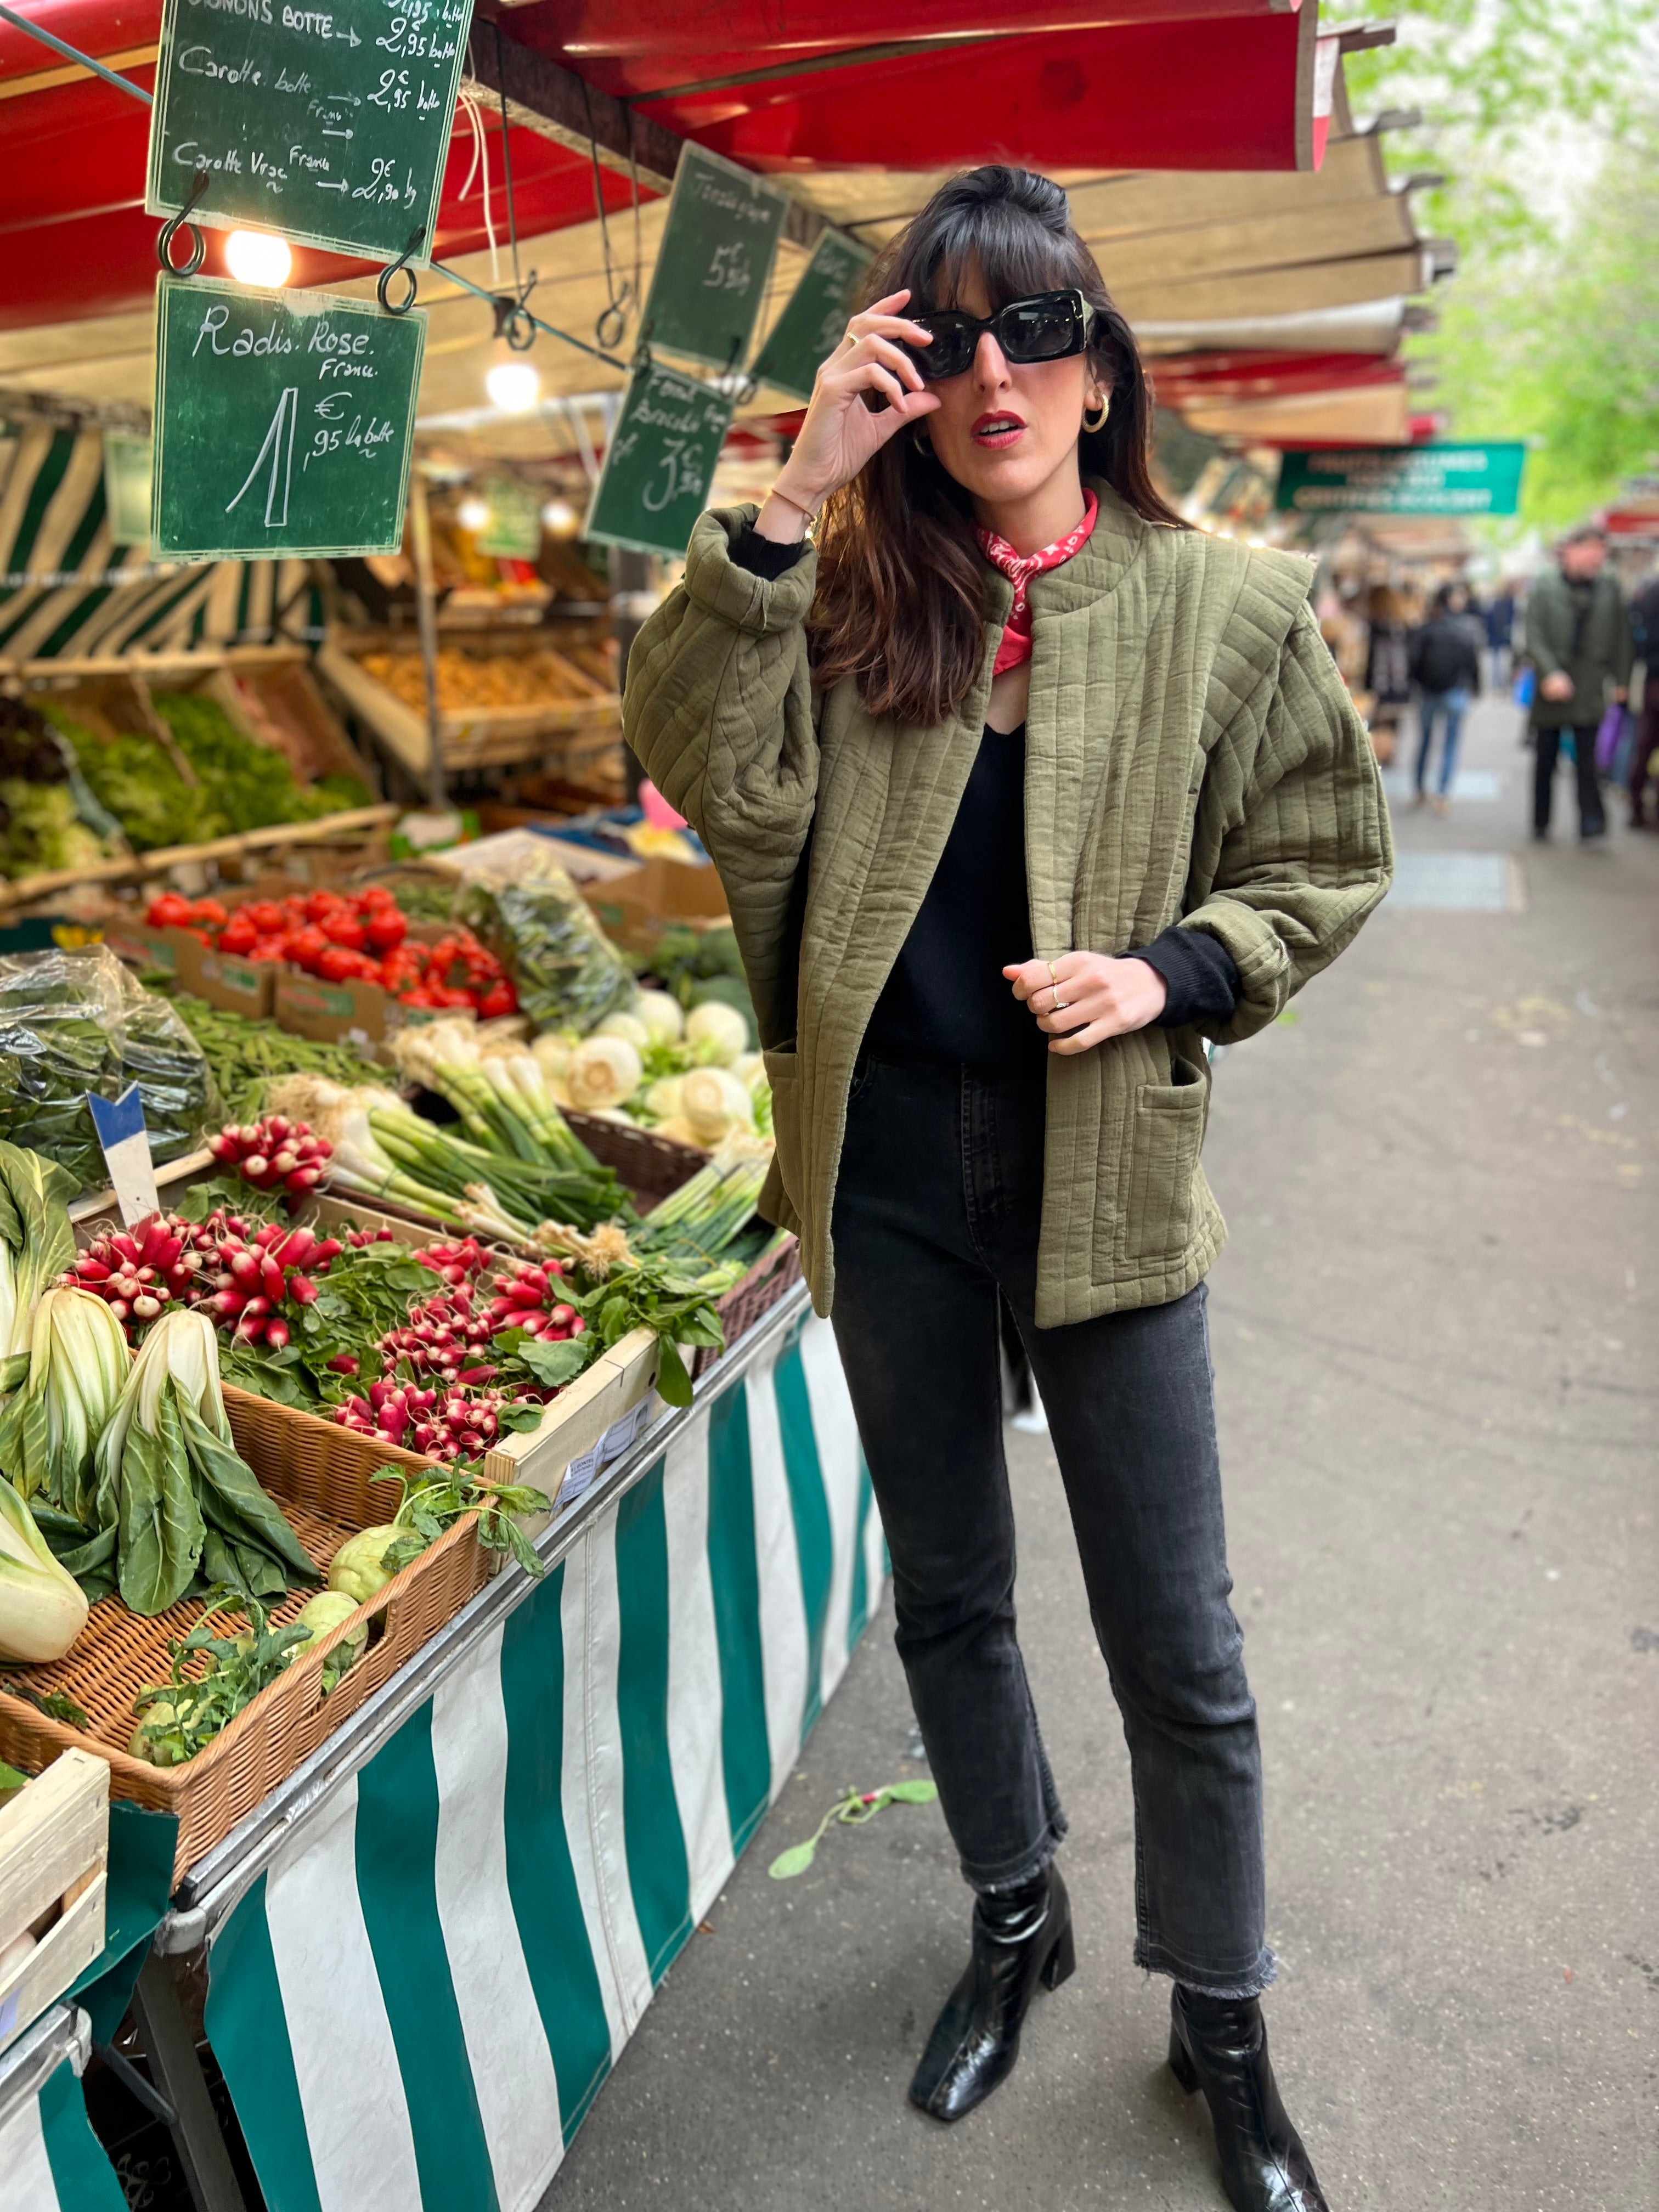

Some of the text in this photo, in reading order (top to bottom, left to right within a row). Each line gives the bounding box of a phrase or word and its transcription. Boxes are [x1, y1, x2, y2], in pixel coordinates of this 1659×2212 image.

[283, 5, 333, 39] BOTTE
[179, 46, 261, 86] Carotte
[172, 142, 241, 174] Carotte
[251, 151, 288, 179] Vrac
